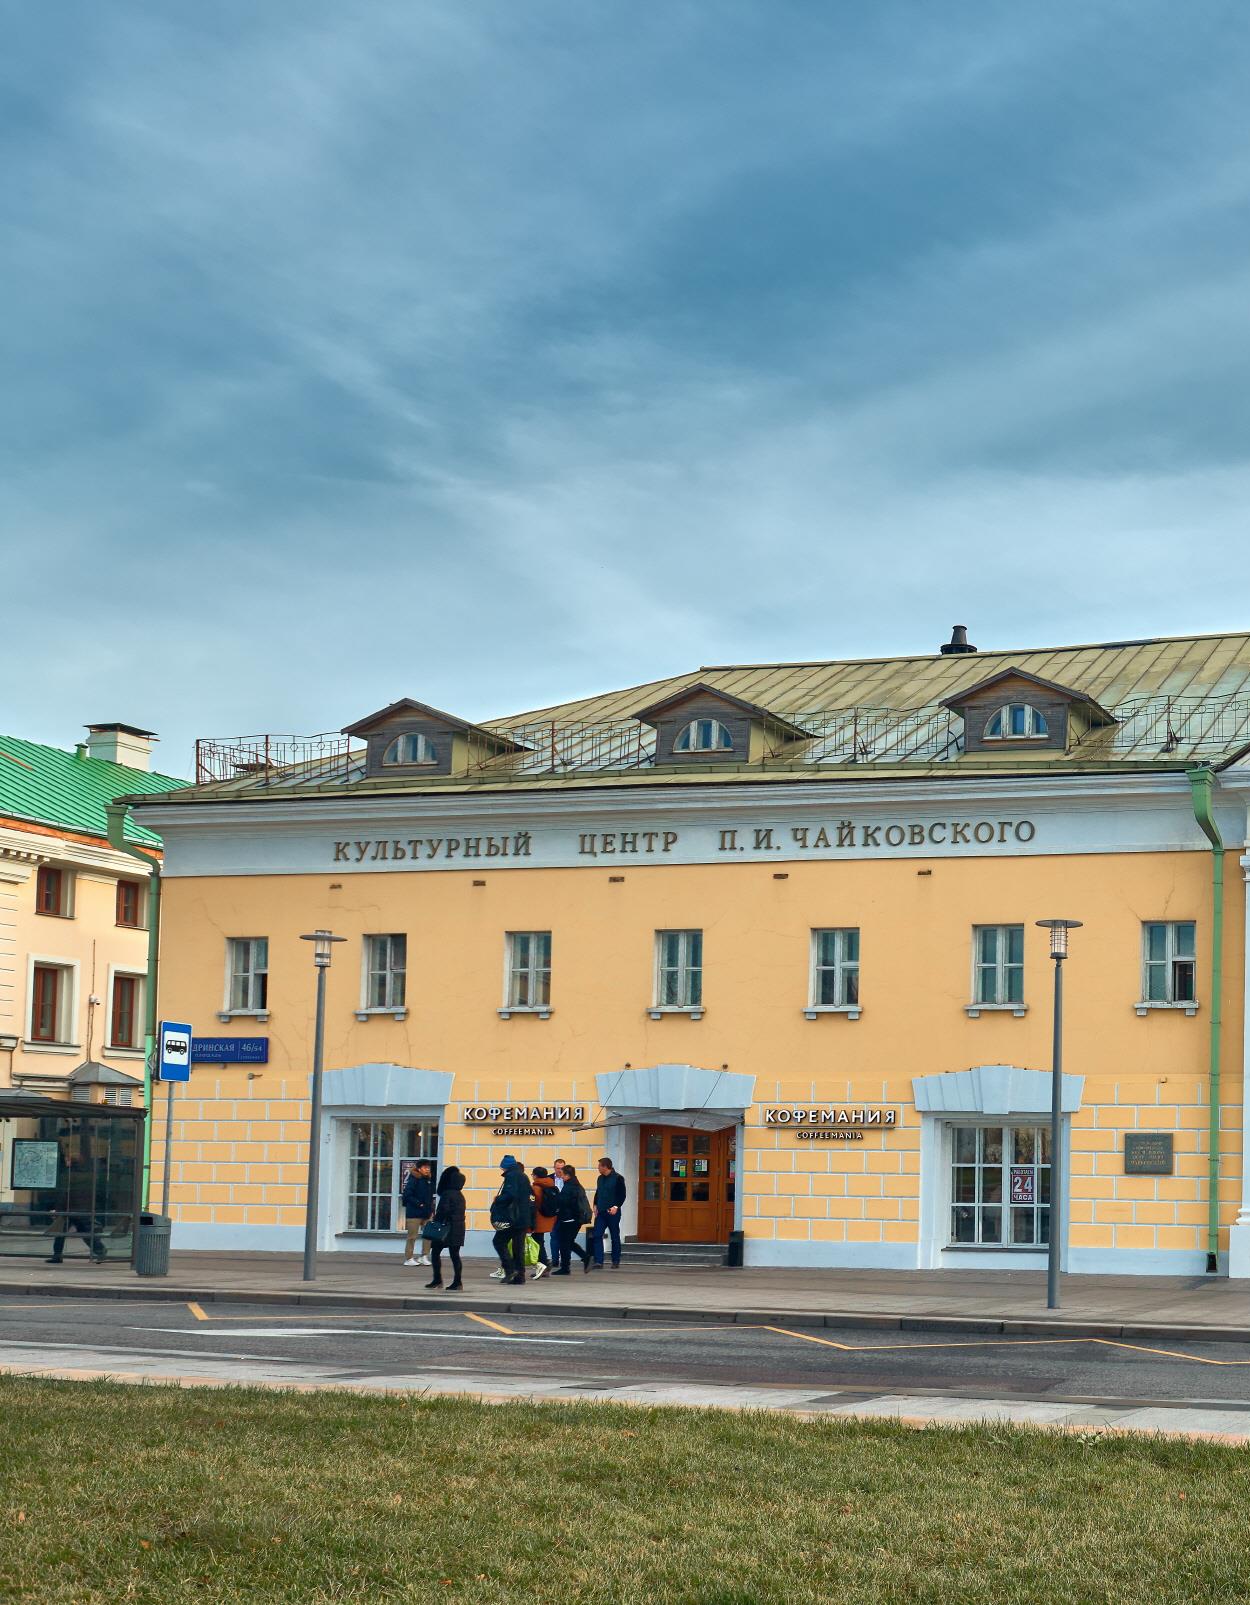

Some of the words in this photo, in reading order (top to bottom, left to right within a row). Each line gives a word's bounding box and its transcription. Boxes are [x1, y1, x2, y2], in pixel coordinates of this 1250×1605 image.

[333, 831, 533, 862] КУЛЬТУРНЫЙ
[578, 831, 678, 857] ЦЕНТР
[791, 820, 1036, 848] ЧАЙКОВСКОГО
[192, 1044, 235, 1052] ДРИНСКАЯ
[464, 1107, 584, 1120] КОФЕМАНИЯ
[765, 1109, 896, 1123] КОФЕМАНИЯ
[492, 1128, 554, 1136] COFFEEMANIA
[1014, 1176, 1033, 1192] 24
